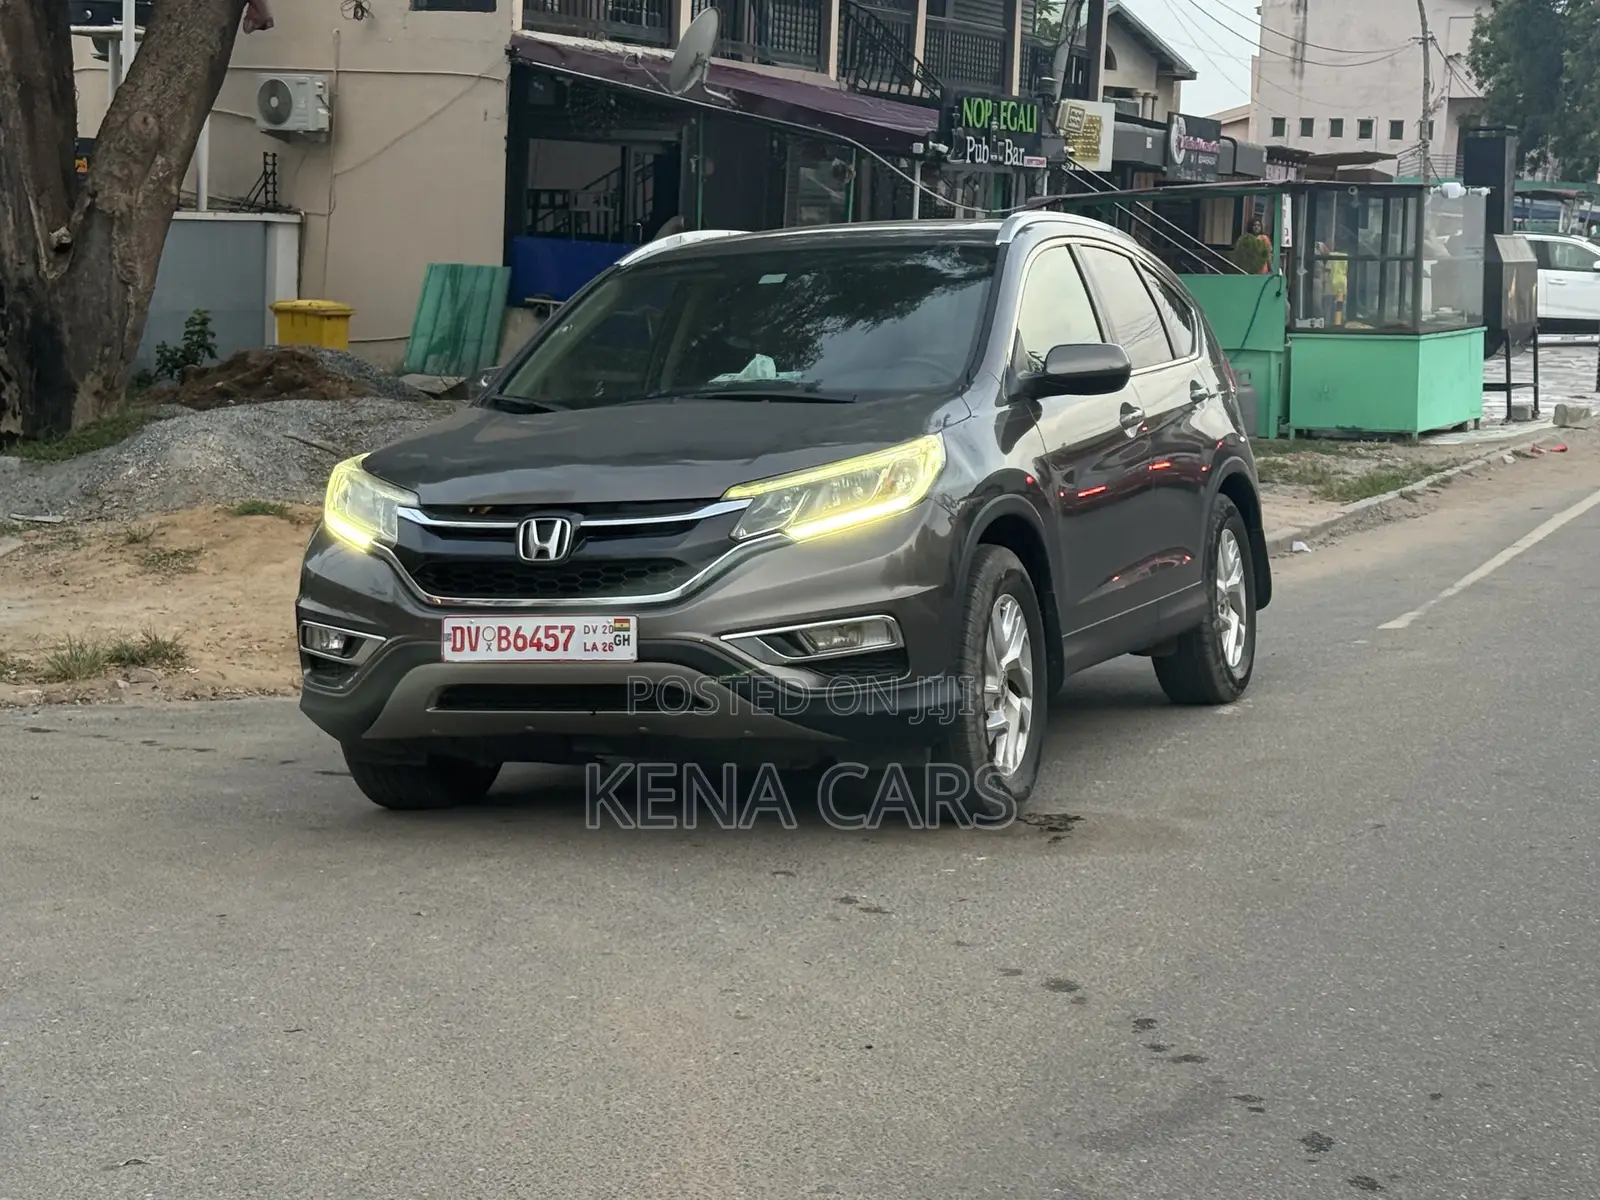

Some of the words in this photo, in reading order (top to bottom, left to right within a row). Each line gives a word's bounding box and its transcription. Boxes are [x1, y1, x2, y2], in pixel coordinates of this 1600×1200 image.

[965, 136, 989, 164] Pub
[1004, 138, 1025, 166] Bar
[583, 624, 598, 635] DV
[602, 624, 614, 635] 20
[451, 625, 481, 652] DV
[497, 625, 576, 652] B6457
[613, 634, 631, 647] GH
[583, 642, 598, 652] LA
[602, 642, 614, 652] 26
